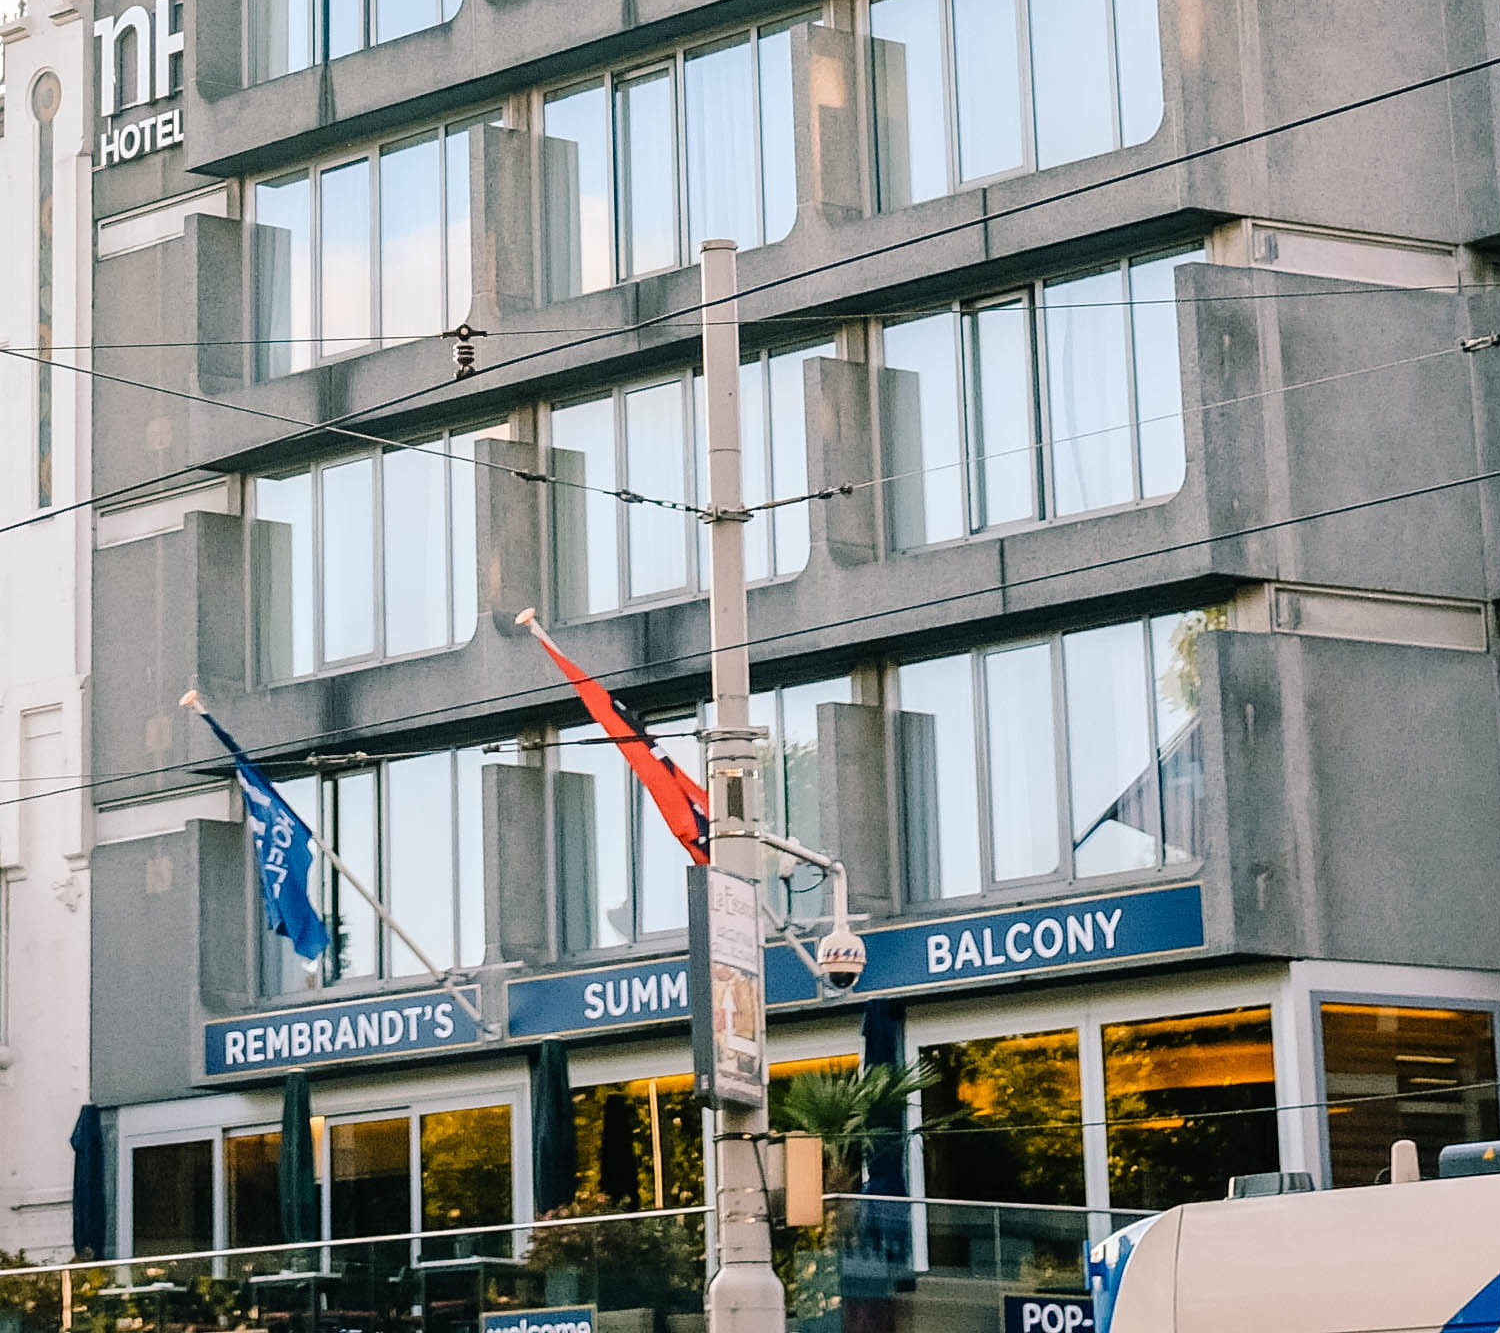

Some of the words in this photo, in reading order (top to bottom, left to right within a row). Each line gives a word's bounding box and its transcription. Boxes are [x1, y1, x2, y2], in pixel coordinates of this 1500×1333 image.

[224, 1003, 455, 1065] REMBRANDT'S
[926, 909, 1124, 975] BALCONY
[1022, 1302, 1095, 1333] POP-
